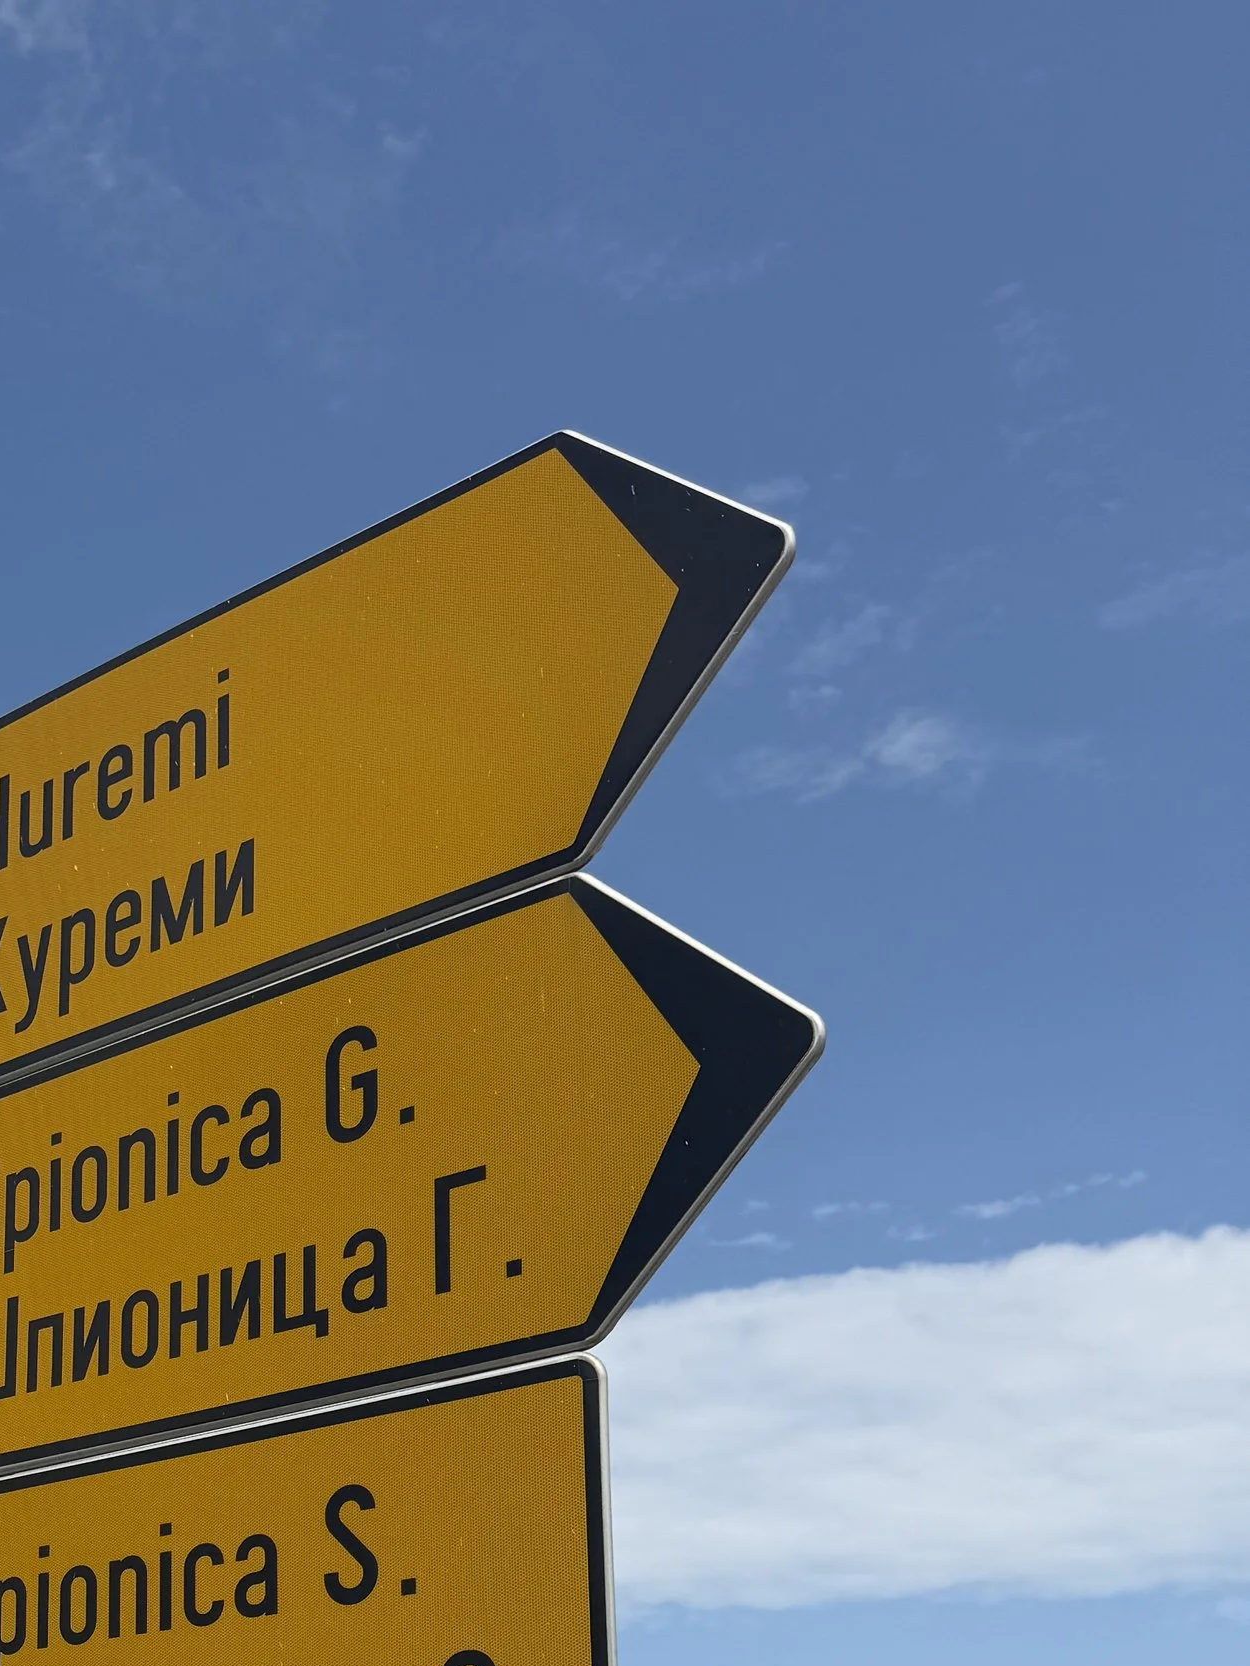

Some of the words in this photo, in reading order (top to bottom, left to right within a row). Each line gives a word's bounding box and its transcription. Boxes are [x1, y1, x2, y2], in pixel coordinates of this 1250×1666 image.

[323, 1024, 416, 1144] G.
[433, 1164, 523, 1296] Г.
[323, 1483, 419, 1607] S.
